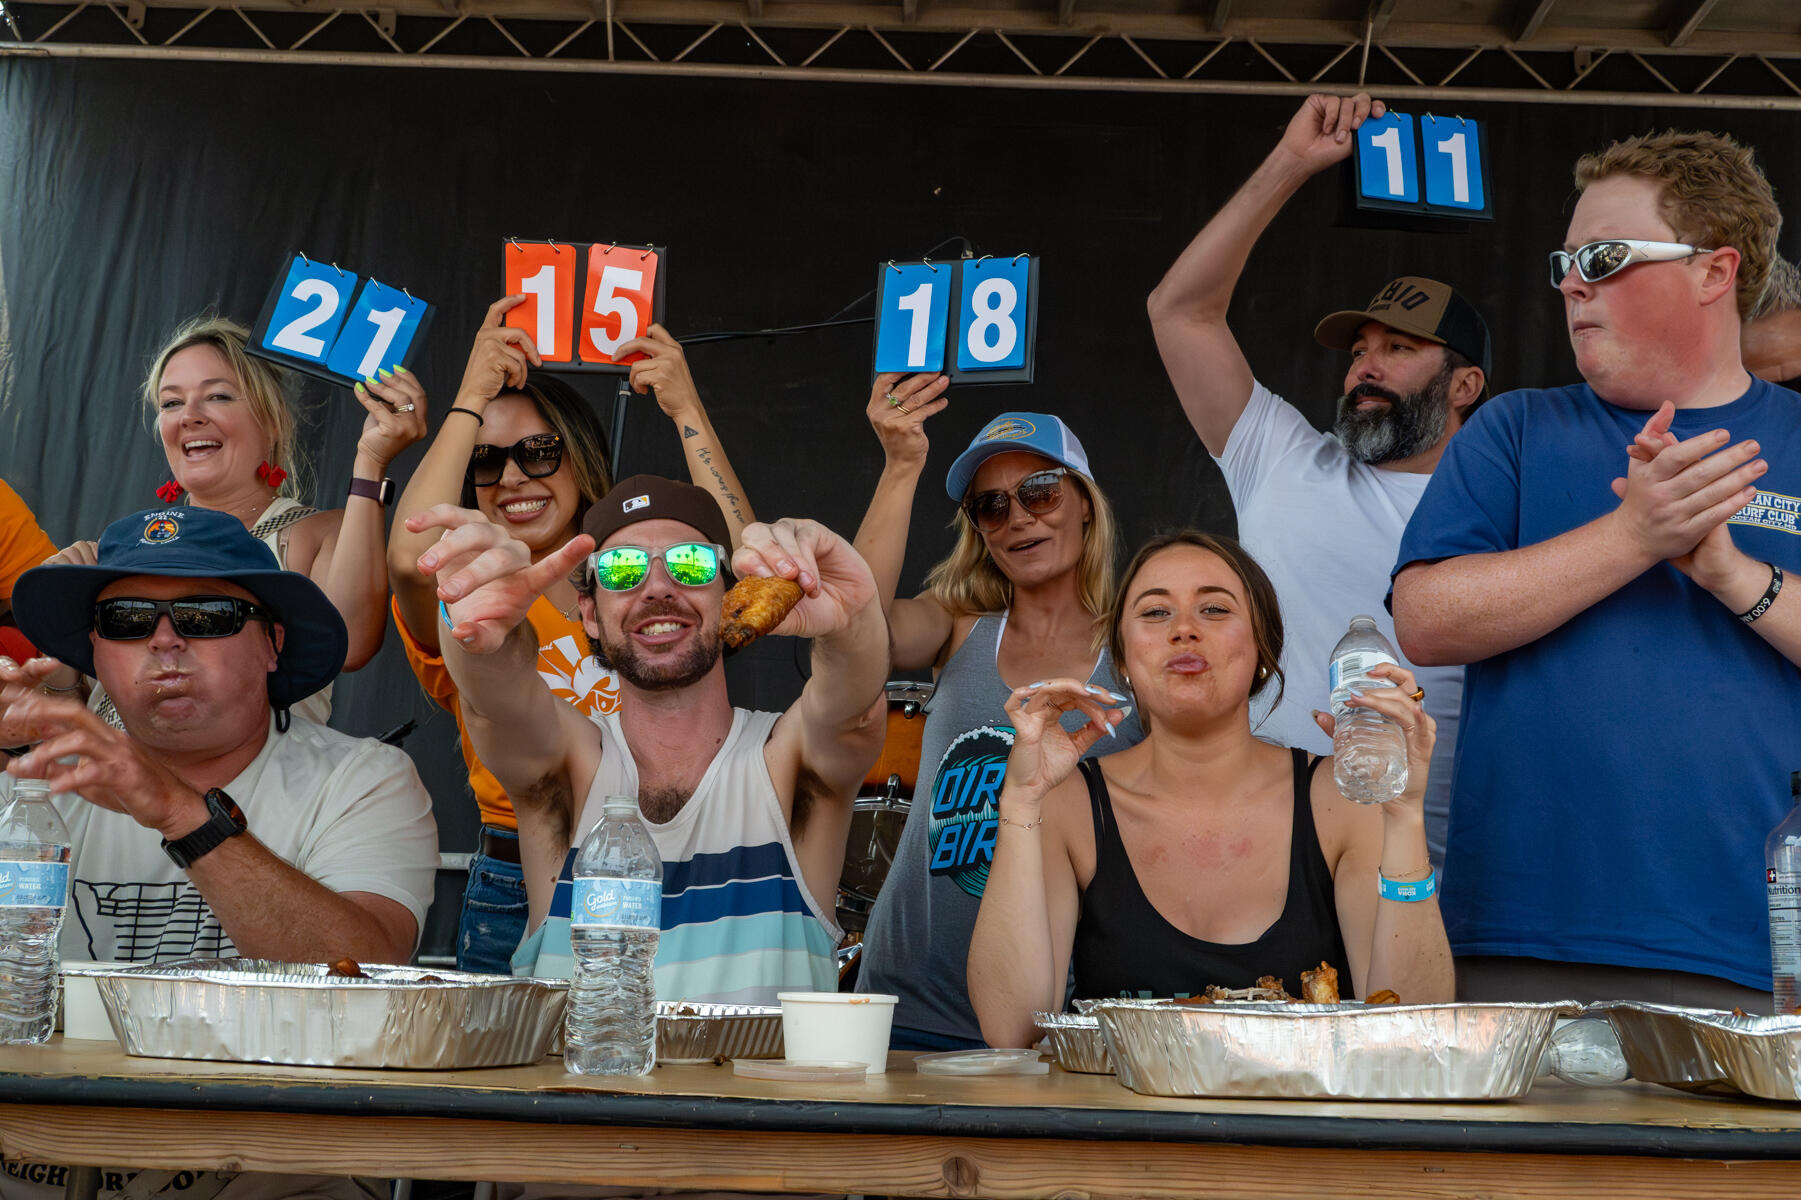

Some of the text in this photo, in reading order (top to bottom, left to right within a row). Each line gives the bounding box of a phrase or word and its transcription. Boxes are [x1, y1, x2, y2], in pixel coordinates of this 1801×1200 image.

[1371, 127, 1470, 203] 11
[521, 264, 644, 357] 15
[898, 277, 1018, 367] 18
[271, 278, 407, 378] 21
[144, 511, 185, 521] ENGINE
[1774, 498, 1801, 512] CITY
[1768, 510, 1796, 525] CLUB
[1752, 597, 1771, 617] 6:00
[586, 889, 616, 912] Gold
